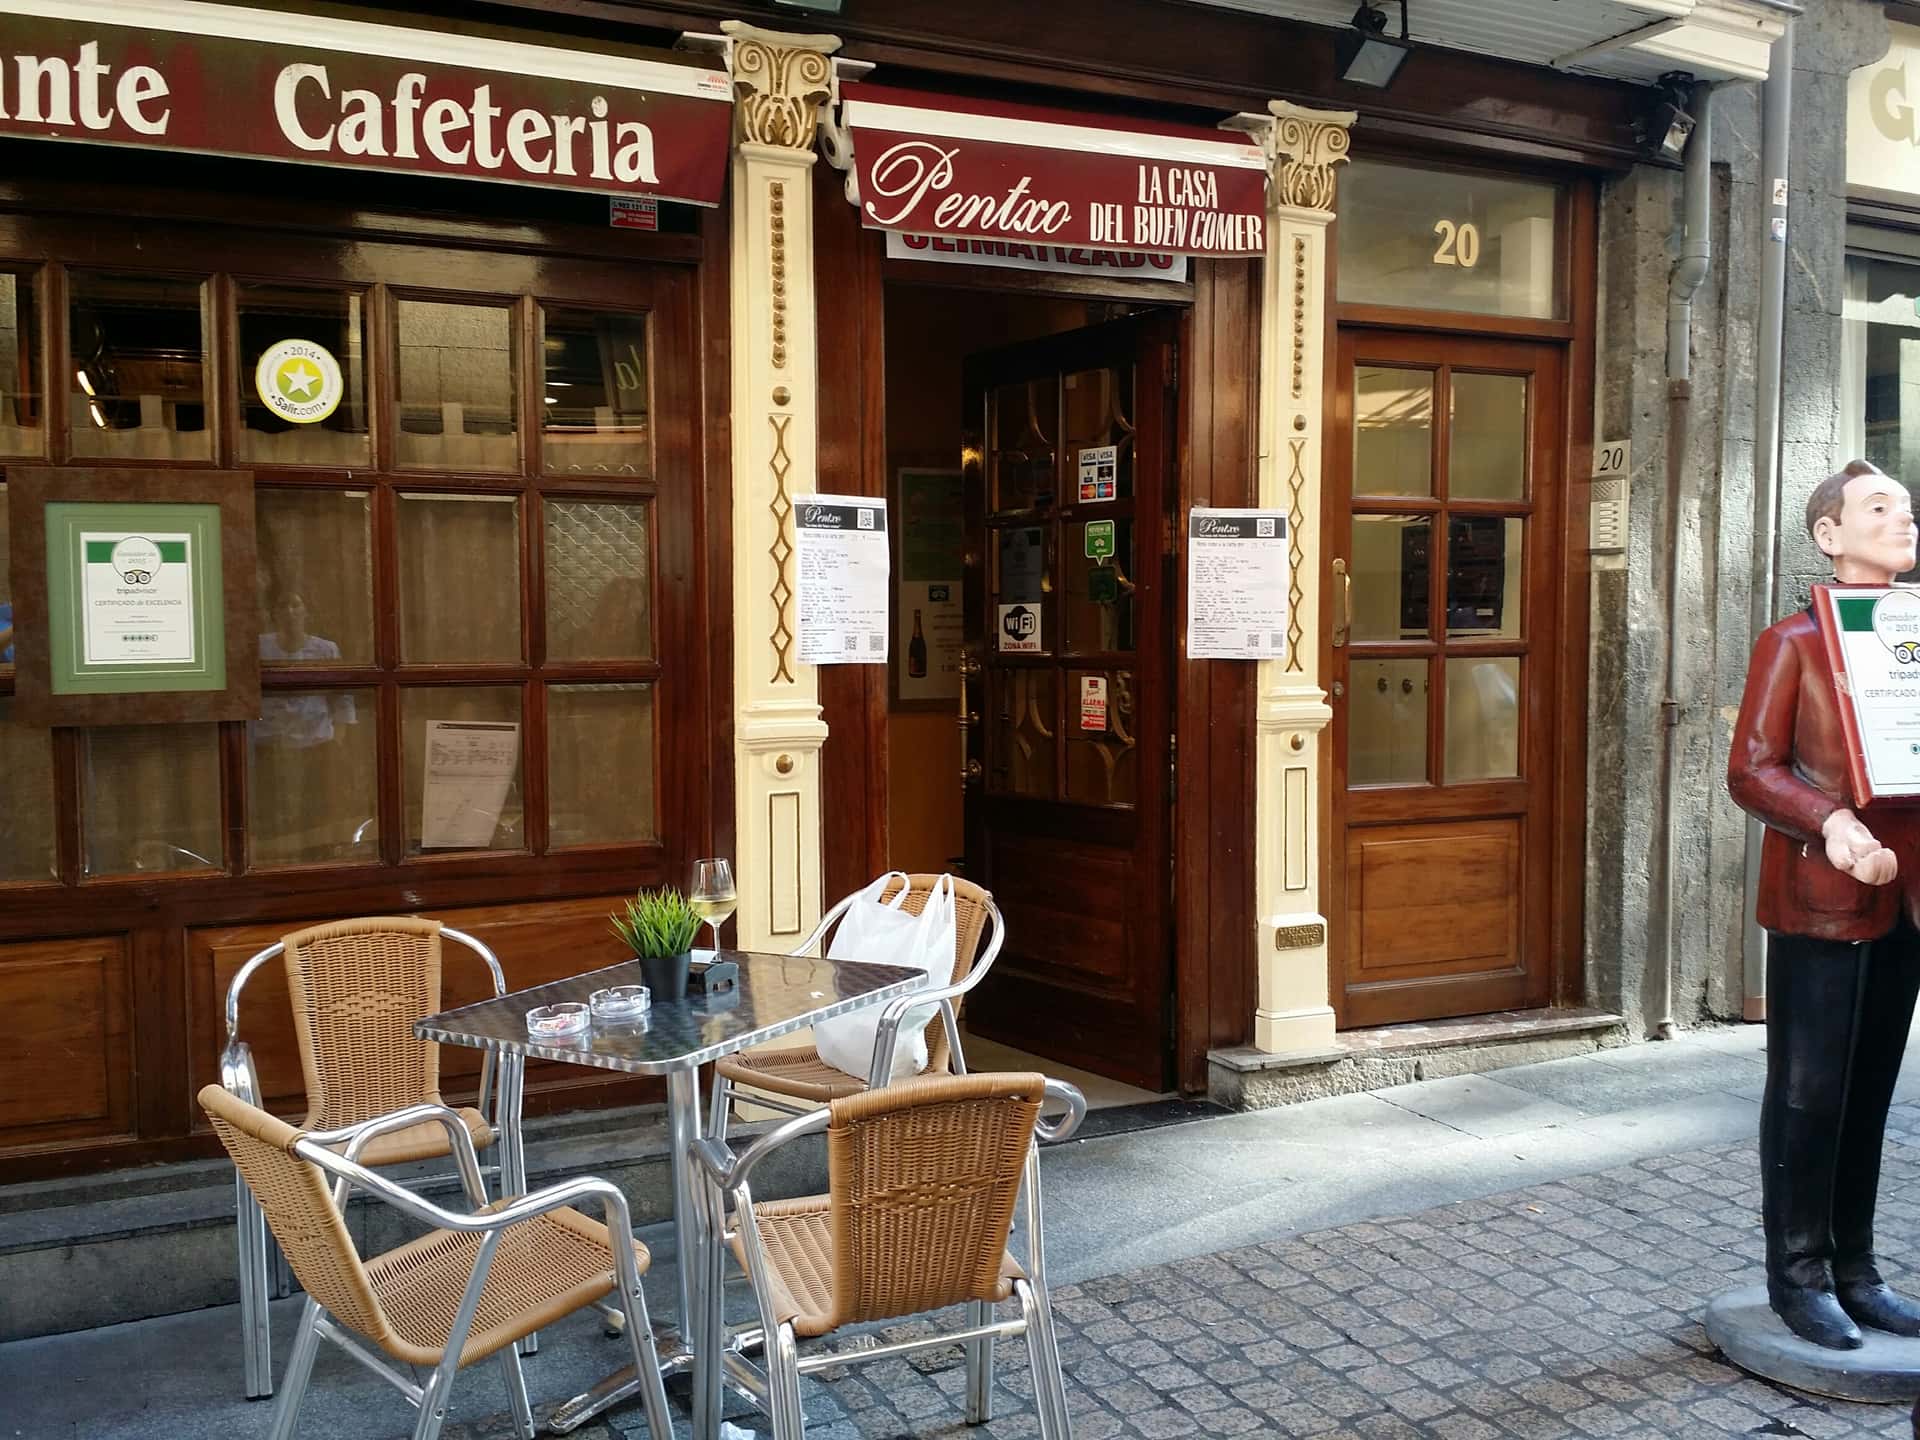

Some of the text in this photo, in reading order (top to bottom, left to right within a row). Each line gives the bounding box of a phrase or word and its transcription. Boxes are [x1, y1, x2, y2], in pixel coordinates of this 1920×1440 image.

[0, 40, 660, 184] nte Cafeteria
[866, 141, 1071, 234] Pentxo
[1138, 165, 1217, 209] LA CASA
[1090, 202, 1263, 252] DEL BUEN COMER
[1433, 219, 1479, 267] 20
[289, 346, 316, 358] 2014
[274, 397, 322, 415] Salir.com
[1599, 447, 1624, 471] 20
[1864, 688, 1918, 698] CERTIFICADO
